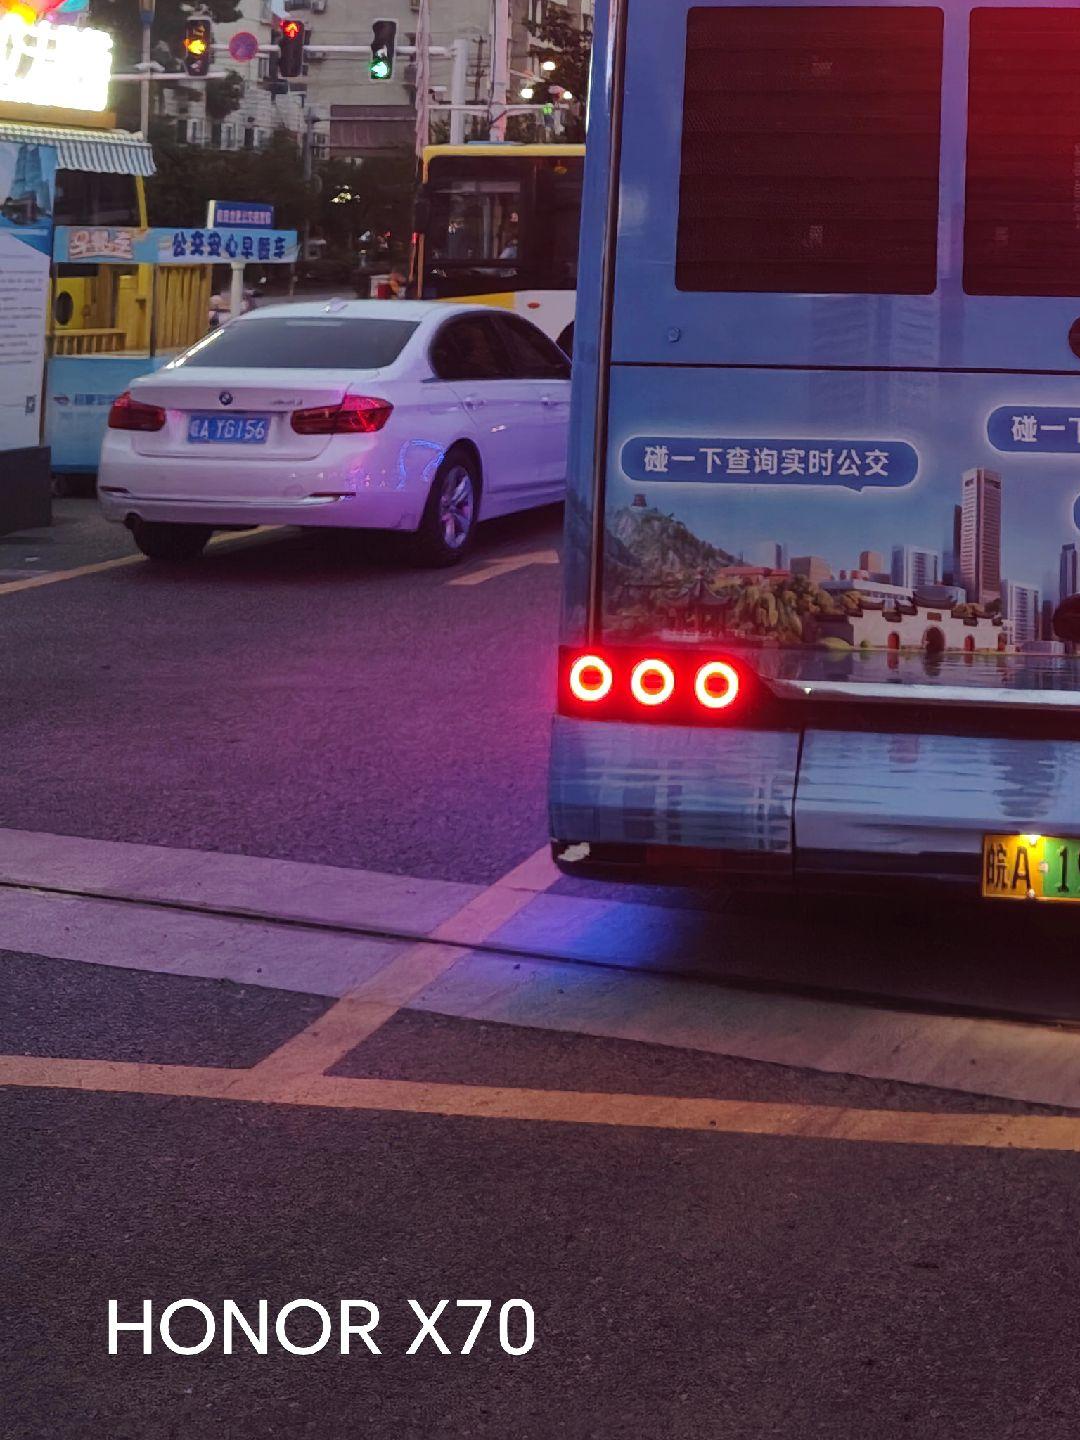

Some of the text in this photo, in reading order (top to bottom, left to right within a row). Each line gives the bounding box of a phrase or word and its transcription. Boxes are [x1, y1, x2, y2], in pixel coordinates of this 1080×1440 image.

[644, 445, 889, 476] 碰一下查询实时公交
